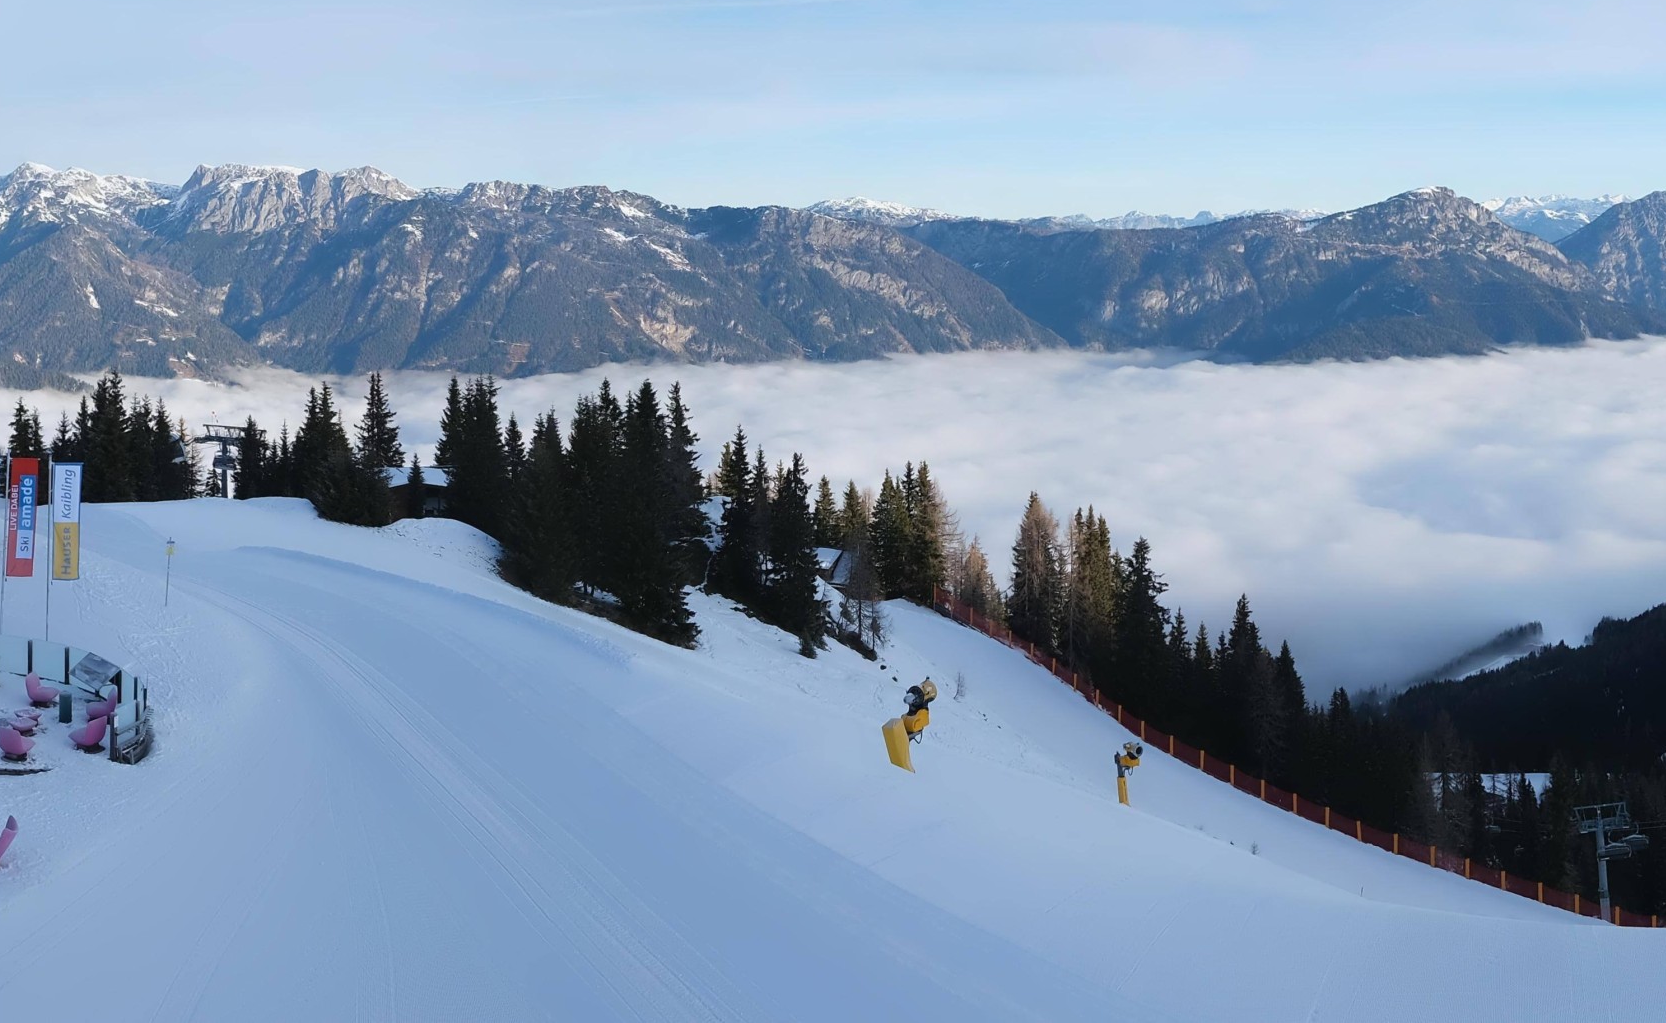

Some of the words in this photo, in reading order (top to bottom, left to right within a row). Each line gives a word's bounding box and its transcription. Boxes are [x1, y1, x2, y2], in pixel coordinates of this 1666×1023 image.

[11, 484, 19, 510] DABEI
[21, 478, 33, 527] amade
[62, 469, 76, 519] Kaibling
[10, 511, 18, 531] LIVE
[20, 536, 30, 552] Ski
[61, 527, 71, 575] HAUSER
